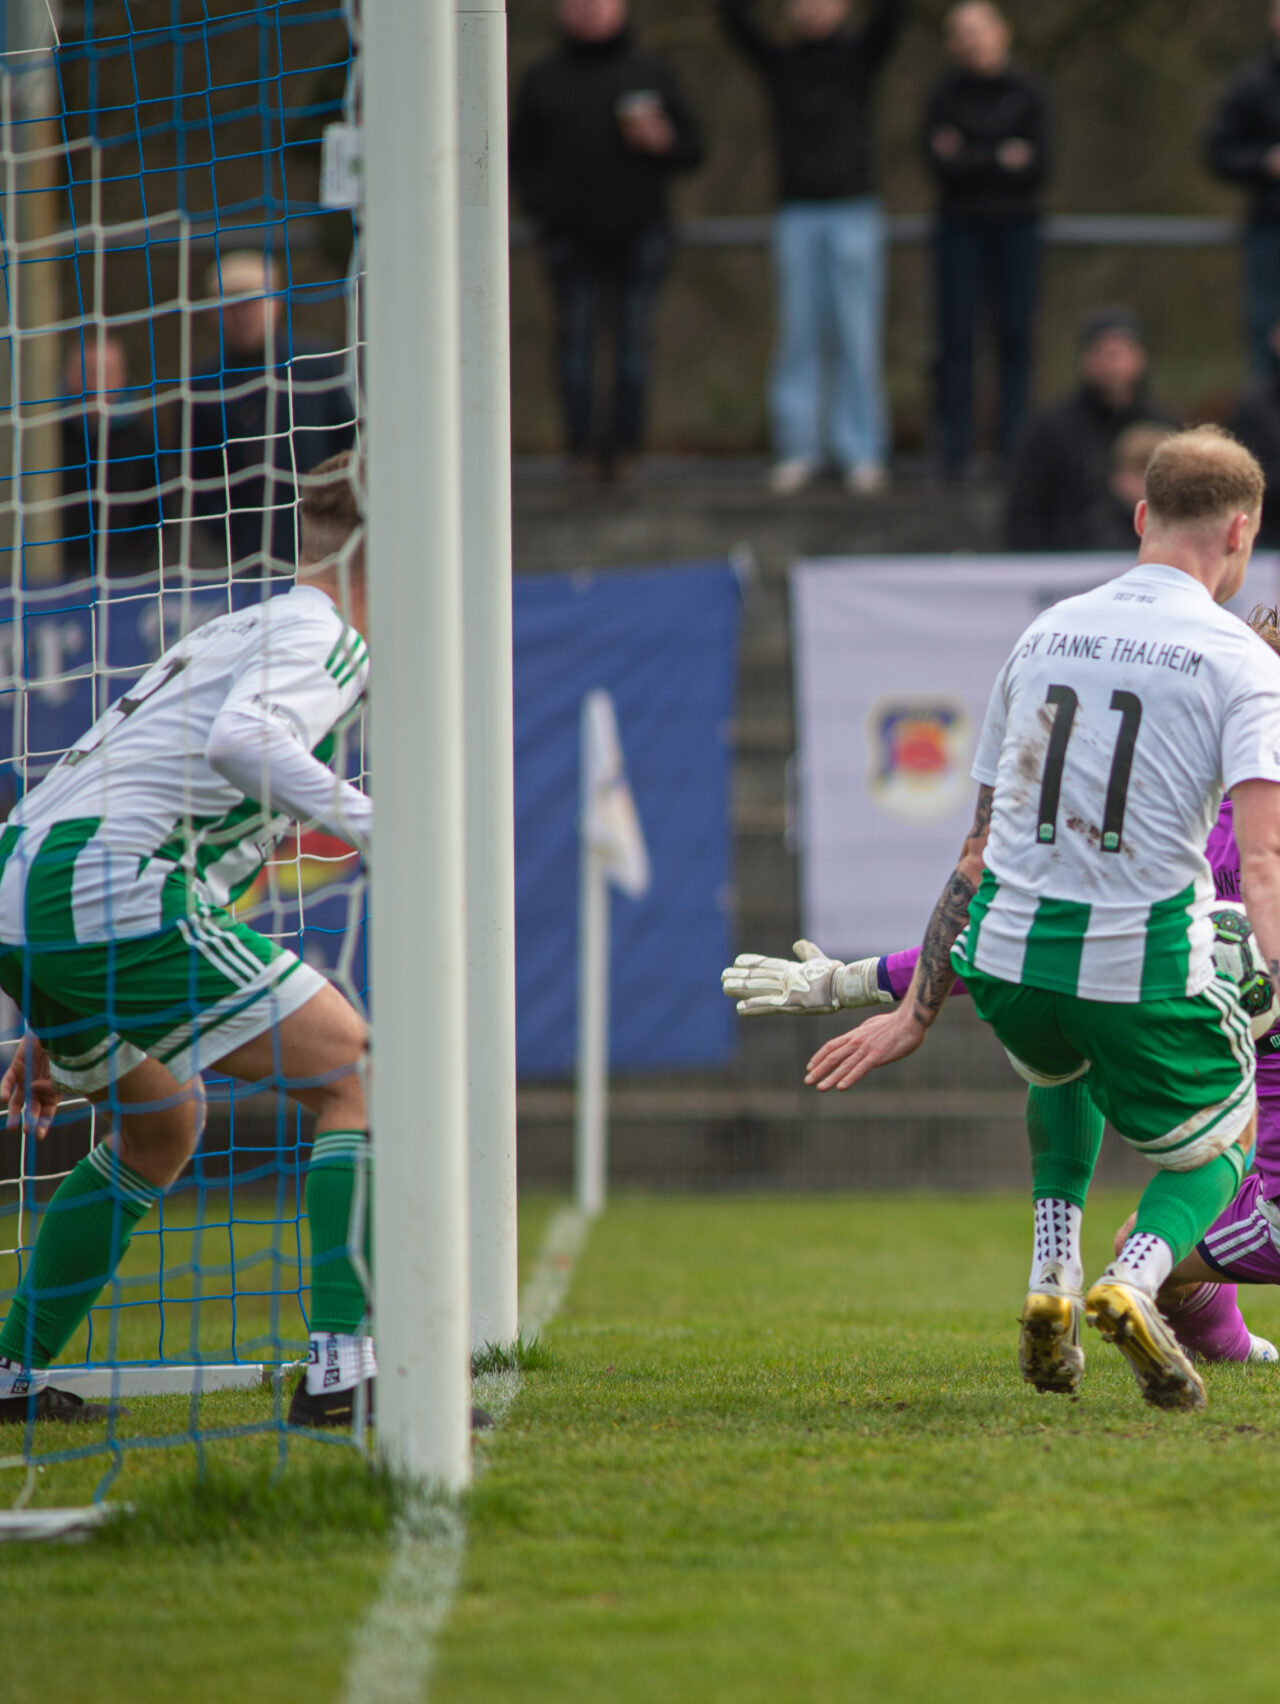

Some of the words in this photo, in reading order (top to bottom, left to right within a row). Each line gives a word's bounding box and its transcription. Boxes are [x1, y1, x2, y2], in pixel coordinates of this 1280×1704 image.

[1047, 632, 1108, 660] TANNE
[1110, 638, 1204, 678] THALHEIM
[1035, 683, 1143, 853] 11
